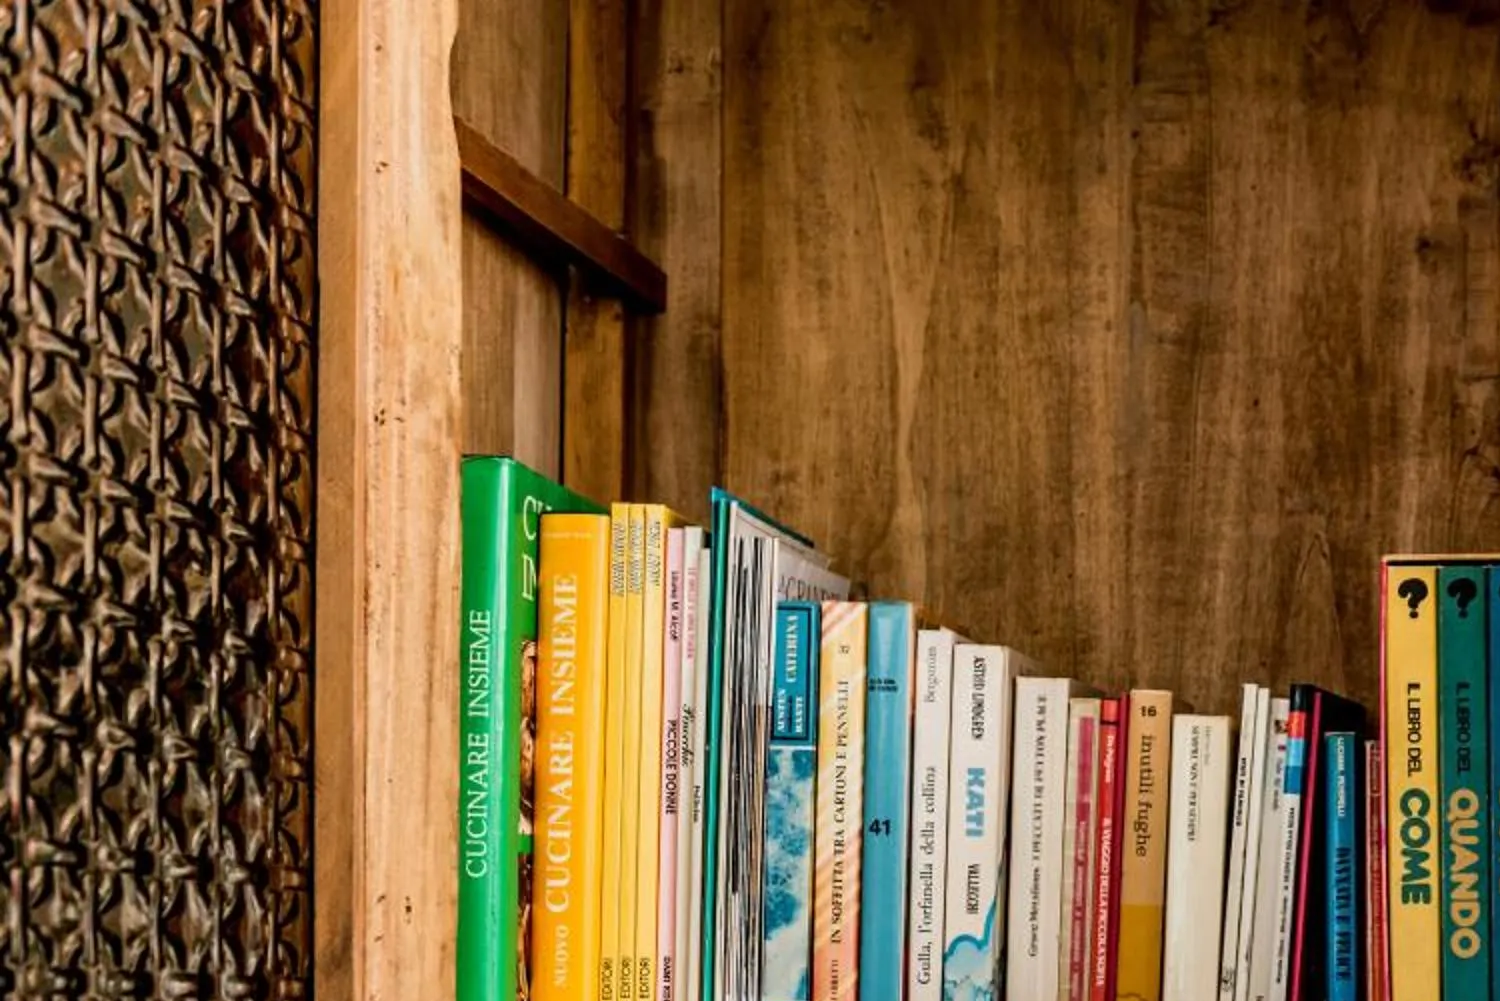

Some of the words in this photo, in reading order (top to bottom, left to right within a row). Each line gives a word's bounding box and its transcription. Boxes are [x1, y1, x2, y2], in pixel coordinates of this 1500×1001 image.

[467, 609, 492, 717] INSIEME
[548, 573, 577, 716] INSIEME
[785, 614, 799, 683] CATERINA
[971, 655, 987, 690] ASTRID
[1407, 682, 1421, 696] IL
[1456, 682, 1470, 694] IL
[835, 680, 849, 748] PENNELLI
[1407, 698, 1422, 743] LIBRO
[1456, 697, 1470, 742] LIBRO
[665, 719, 678, 770] PICCOLE
[1138, 734, 1157, 796] inutili
[1406, 747, 1421, 777] DEL
[1456, 746, 1470, 775] DEL
[464, 732, 490, 878] CUCINARE
[665, 773, 677, 815] DONNE
[833, 764, 847, 824] CARTONI
[921, 766, 937, 814] collina
[965, 766, 986, 838] KATI
[544, 731, 574, 913] CUCINARE
[832, 828, 846, 857] TRA
[868, 818, 892, 836] 41
[919, 821, 936, 855] della
[1135, 799, 1155, 858] fughe
[1101, 829, 1112, 873] VIAGGIO
[1400, 787, 1432, 906] COME
[831, 859, 844, 925] SOFFITTA
[1099, 874, 1110, 907] DELLA
[1446, 788, 1481, 959] QUANDO
[917, 863, 936, 934] l'orfanella
[830, 928, 843, 945] IN
[602, 957, 614, 1001] EDITORI
[621, 957, 632, 999] EDITORI
[639, 957, 651, 999] EDITORI
[916, 940, 935, 986] Gulla,
